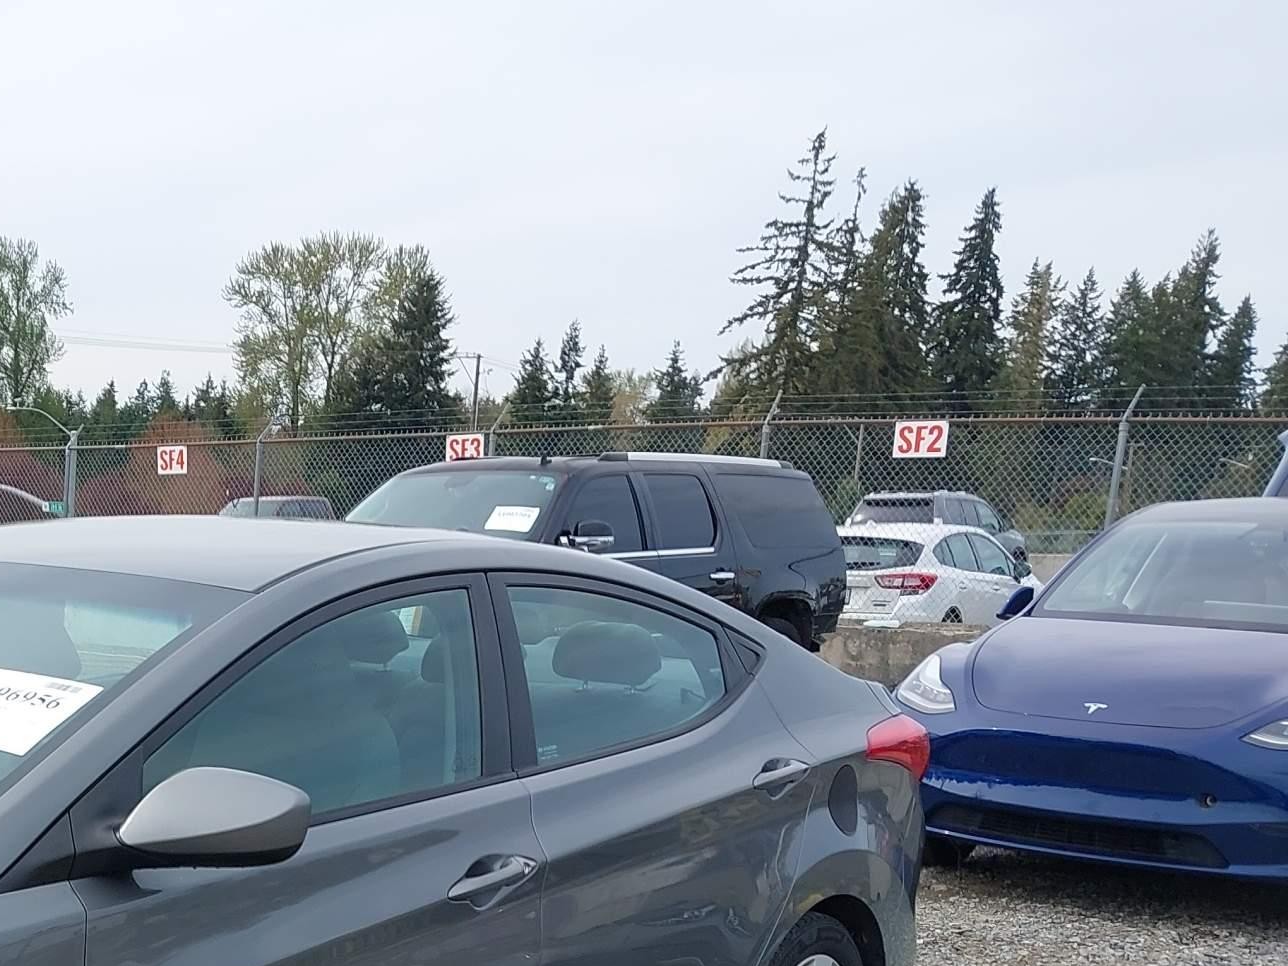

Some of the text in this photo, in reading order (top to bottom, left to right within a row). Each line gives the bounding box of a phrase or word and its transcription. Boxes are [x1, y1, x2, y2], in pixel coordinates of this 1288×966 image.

[449, 437, 481, 459] SF3
[897, 425, 943, 453] SF2
[159, 448, 185, 471] SF4
